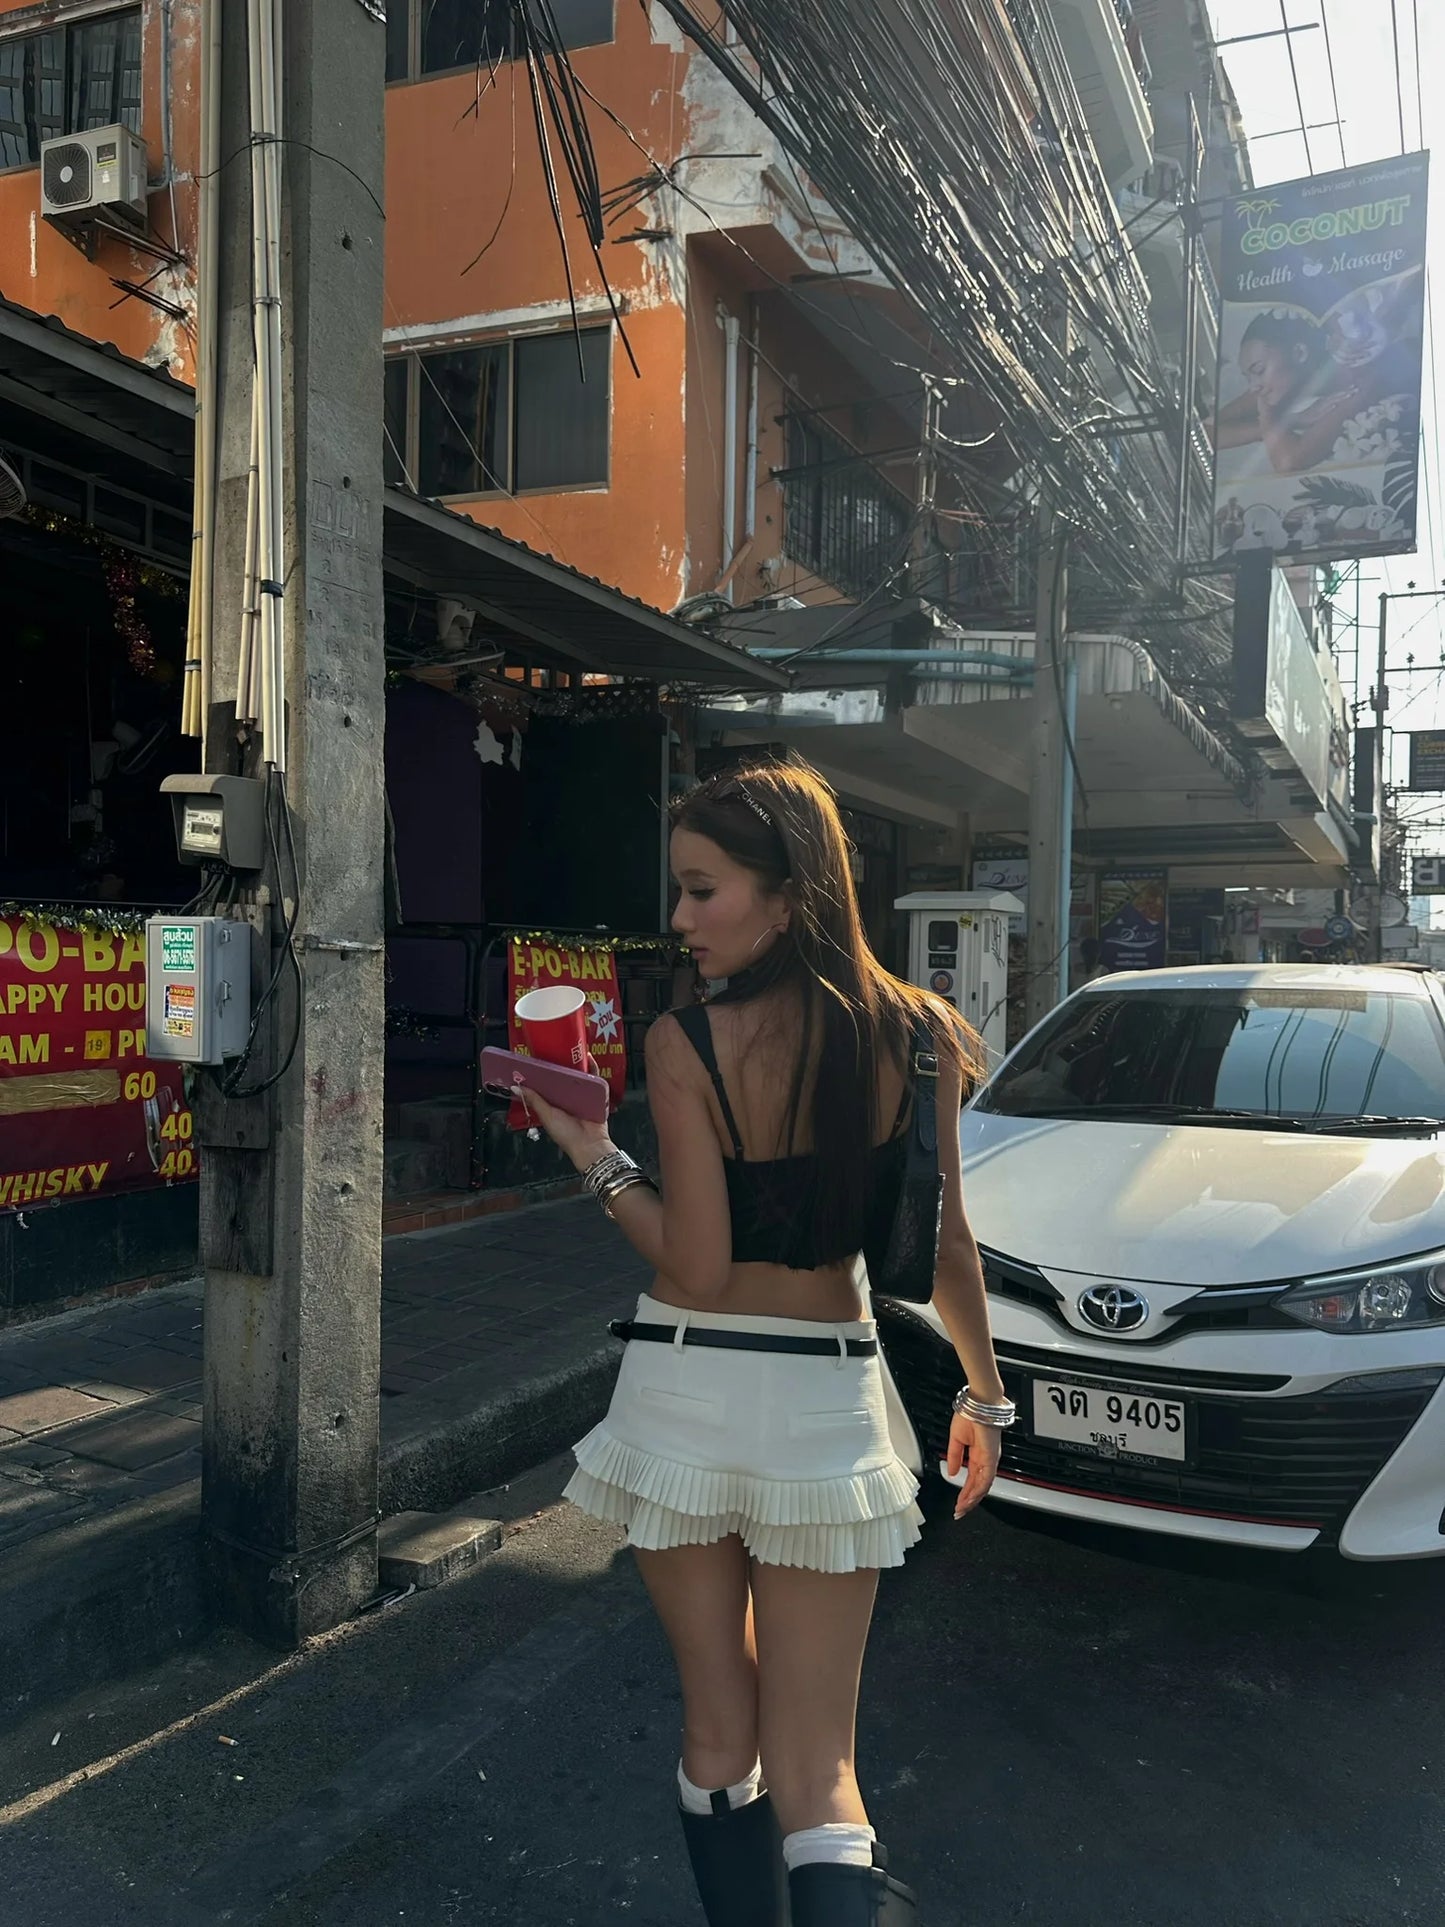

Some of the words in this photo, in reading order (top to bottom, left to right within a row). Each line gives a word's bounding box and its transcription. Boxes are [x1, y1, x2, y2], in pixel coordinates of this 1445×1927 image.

[1241, 194, 1411, 255] COCONUT
[1237, 264, 1294, 291] Health
[1328, 248, 1406, 274] Massage
[741, 792, 771, 825] CHANEL
[163, 928, 194, 945] สูบส้วม
[513, 945, 613, 980] E-PO-BAR
[0, 984, 68, 1014] PPY
[598, 1010, 614, 1029] ด่วน
[124, 1071, 156, 1100] 60
[161, 1112, 192, 1140] 40
[1047, 1386, 1088, 1418] จต
[1106, 1396, 1181, 1432] 9405
[1057, 1441, 1096, 1454] JUNCTION
[1118, 1453, 1158, 1465] PRODUCE
[1090, 1432, 1127, 1447] ชลบุรี
